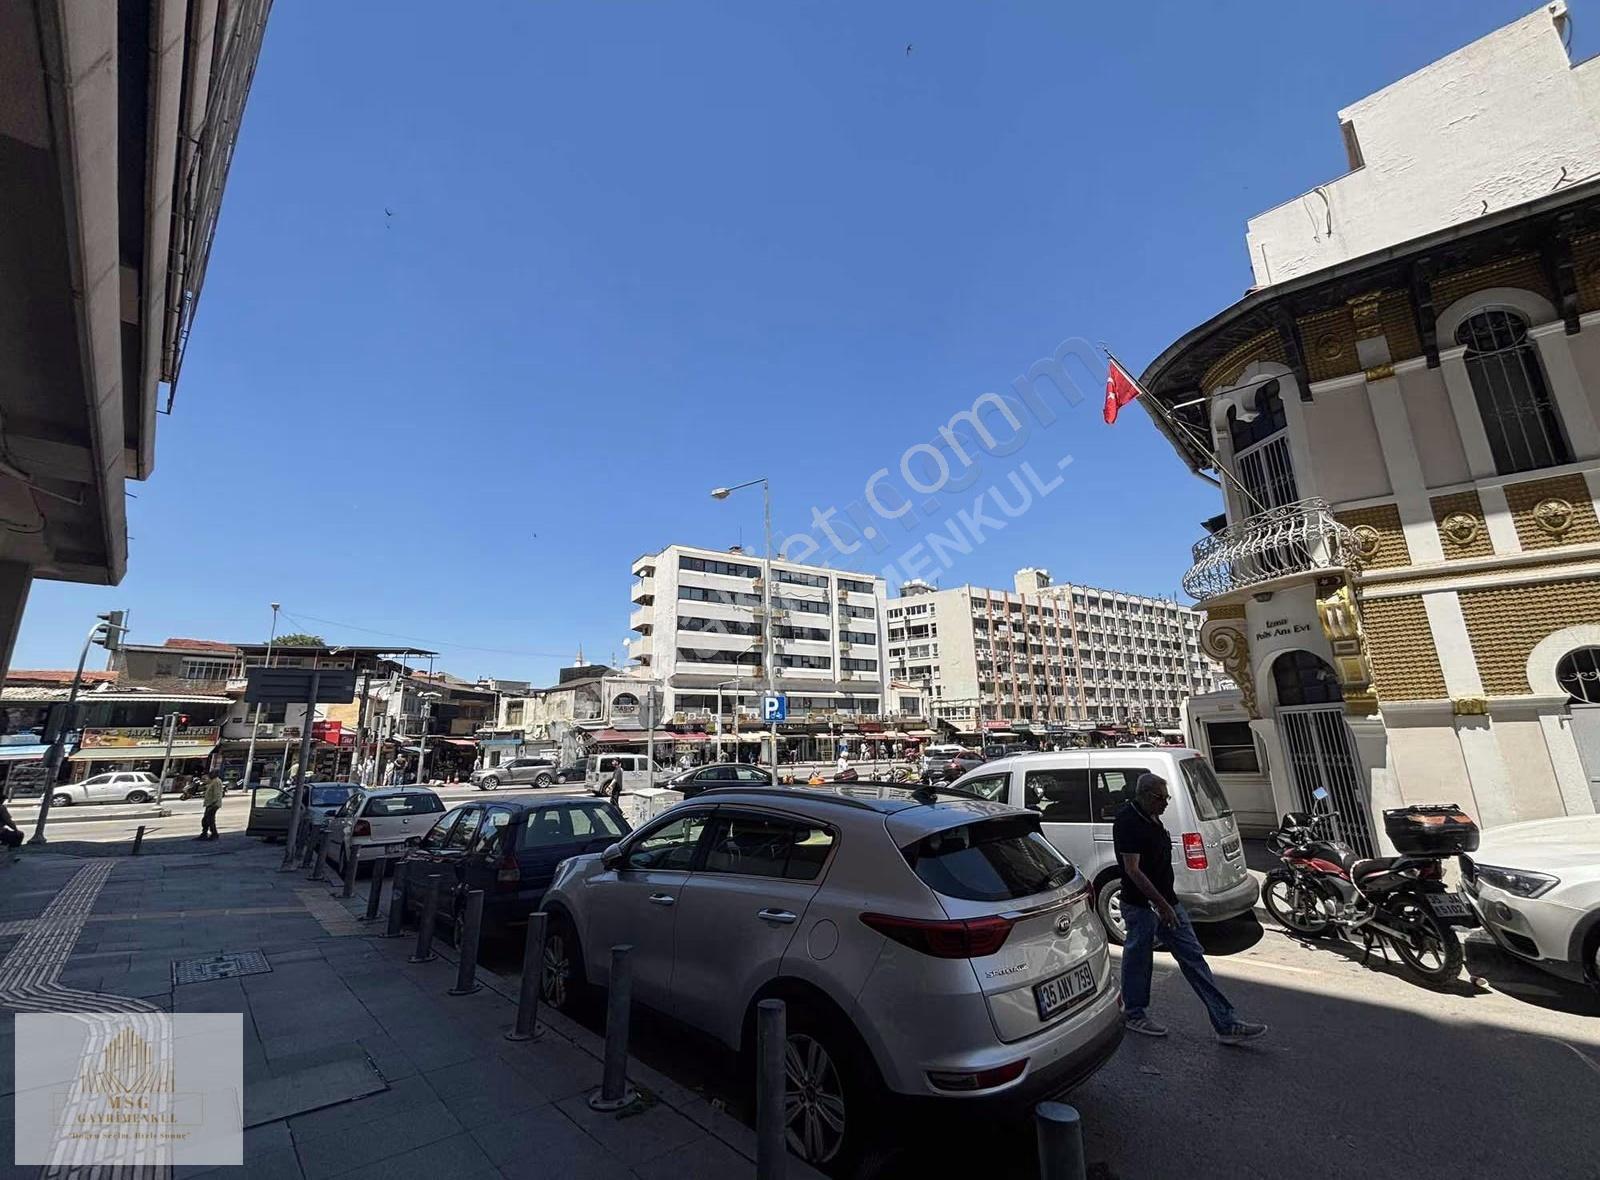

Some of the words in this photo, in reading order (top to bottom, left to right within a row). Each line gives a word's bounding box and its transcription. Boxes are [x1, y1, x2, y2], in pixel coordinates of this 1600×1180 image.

[765, 697, 779, 720] P
[1043, 984, 1058, 1008] 35
[1059, 976, 1075, 1001] ANY
[1074, 966, 1092, 992] 759
